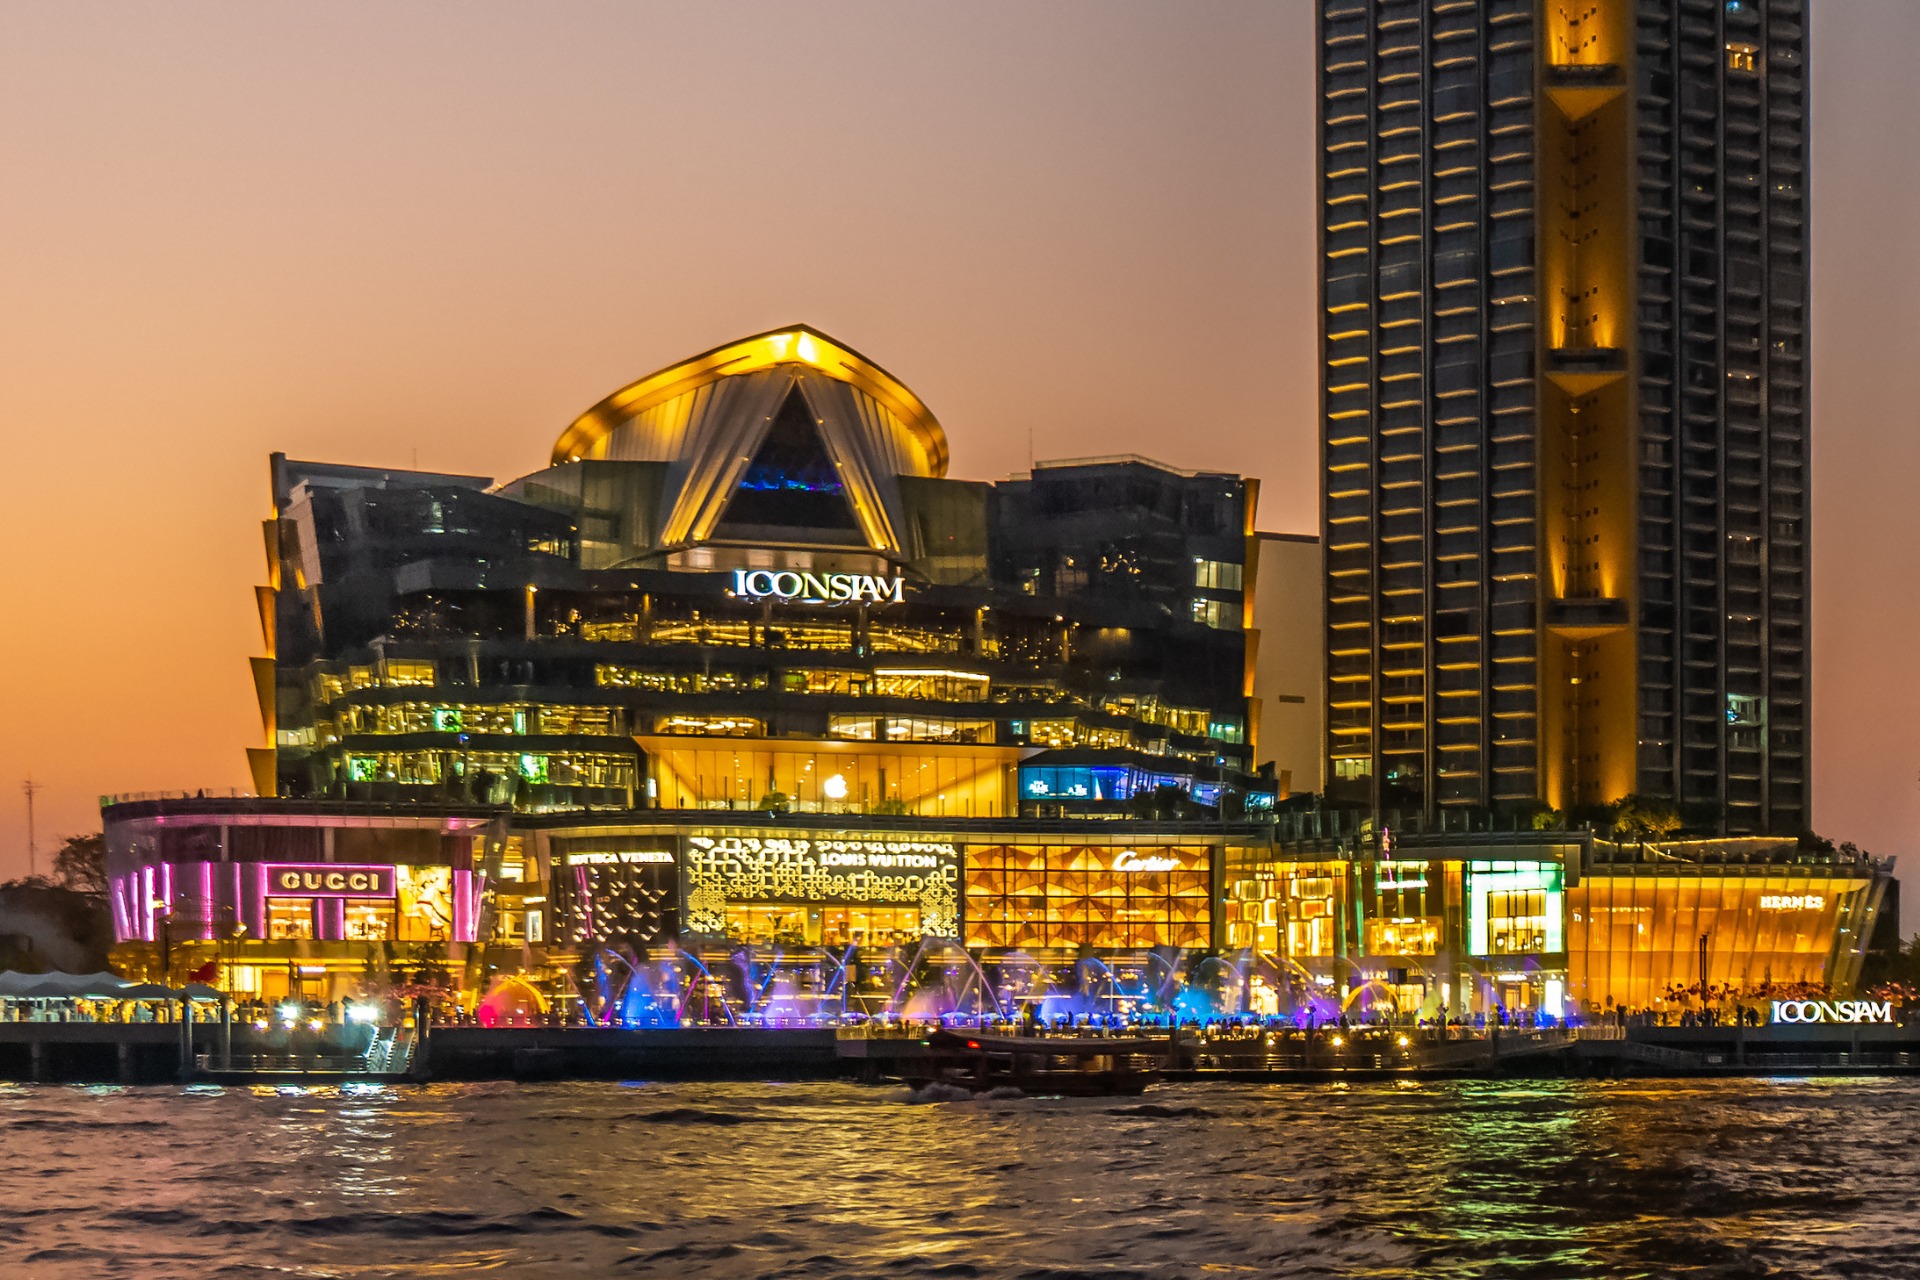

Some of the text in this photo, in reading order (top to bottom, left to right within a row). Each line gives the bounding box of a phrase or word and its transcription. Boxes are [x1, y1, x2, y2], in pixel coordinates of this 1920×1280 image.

[735, 569, 906, 603] ICONSIAM
[619, 851, 675, 863] VENETA
[819, 853, 937, 868] LOUIS VUITTON
[1111, 850, 1181, 871] Cartier
[281, 871, 379, 890] GUCCI
[1771, 1000, 1893, 1023] ICONSIAM
